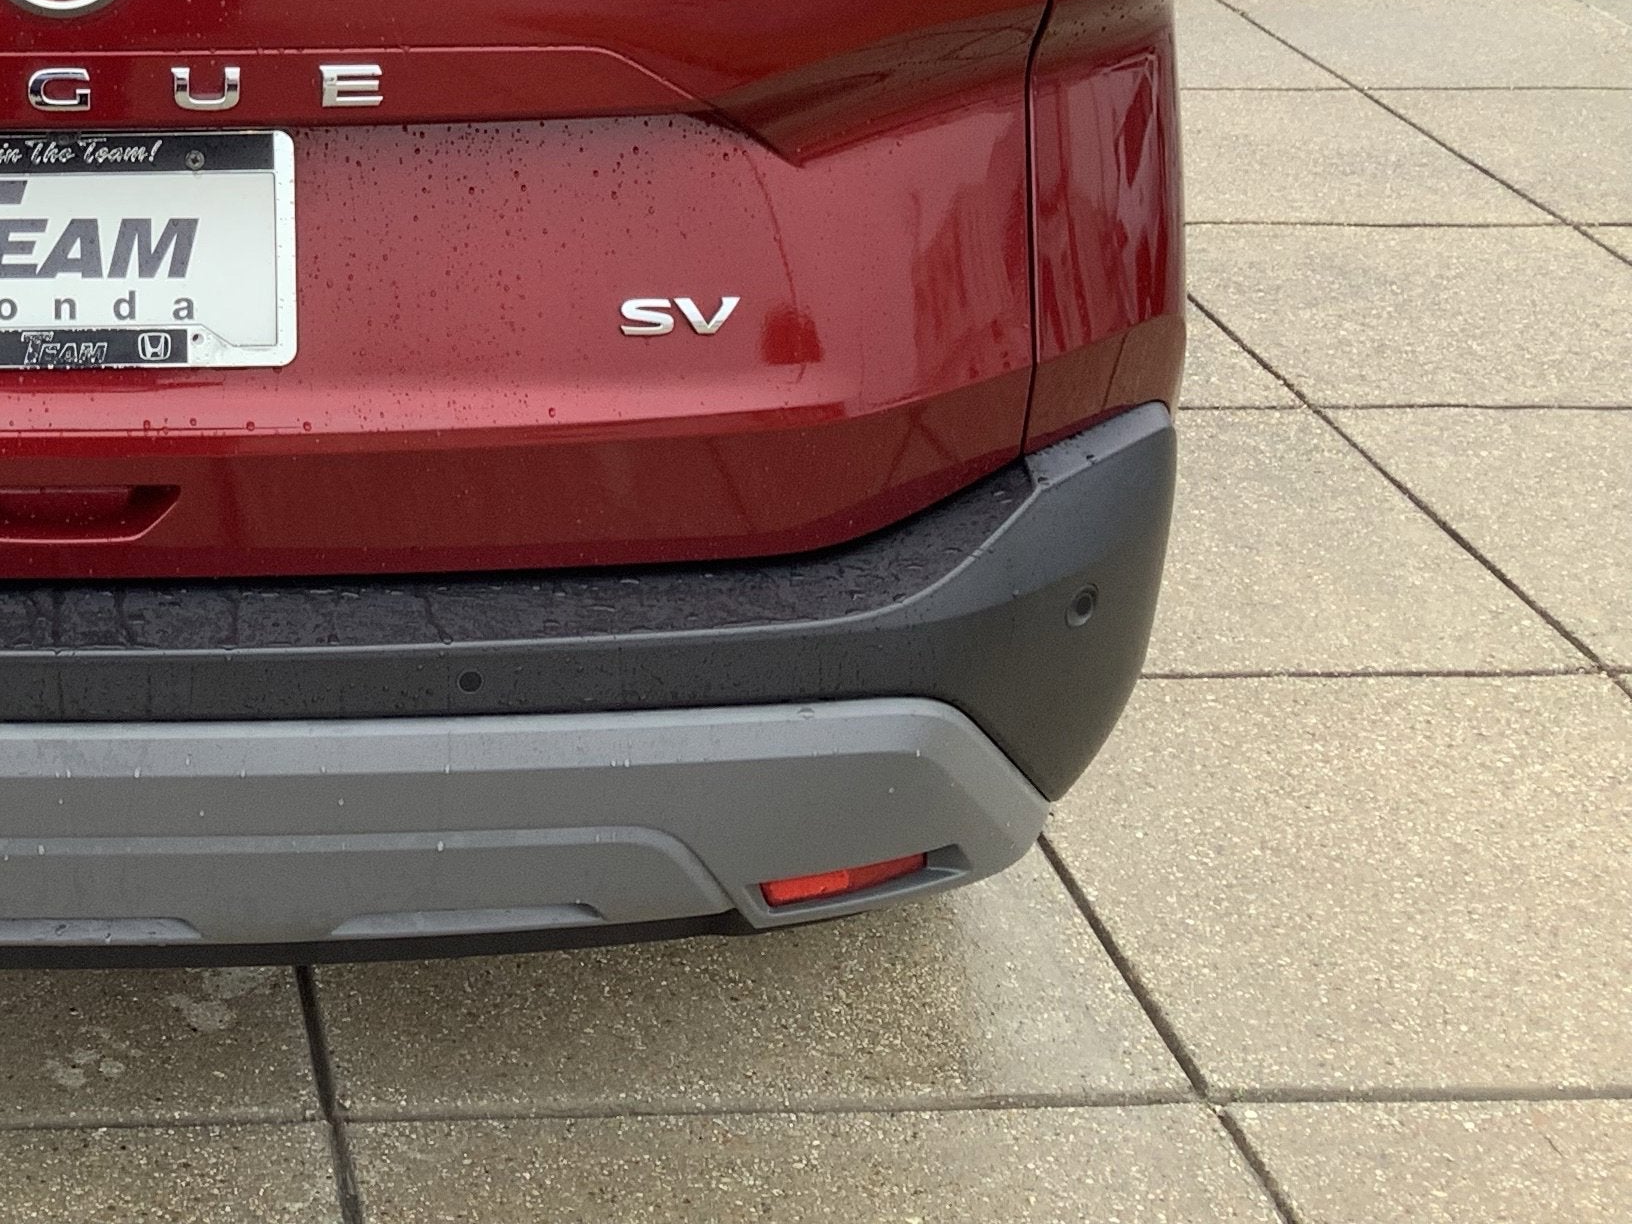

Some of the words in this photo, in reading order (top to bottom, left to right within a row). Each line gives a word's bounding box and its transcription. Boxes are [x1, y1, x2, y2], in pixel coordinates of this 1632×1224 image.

[25, 139, 75, 165] The
[620, 296, 741, 336] SV
[21, 331, 108, 365] TEAM
